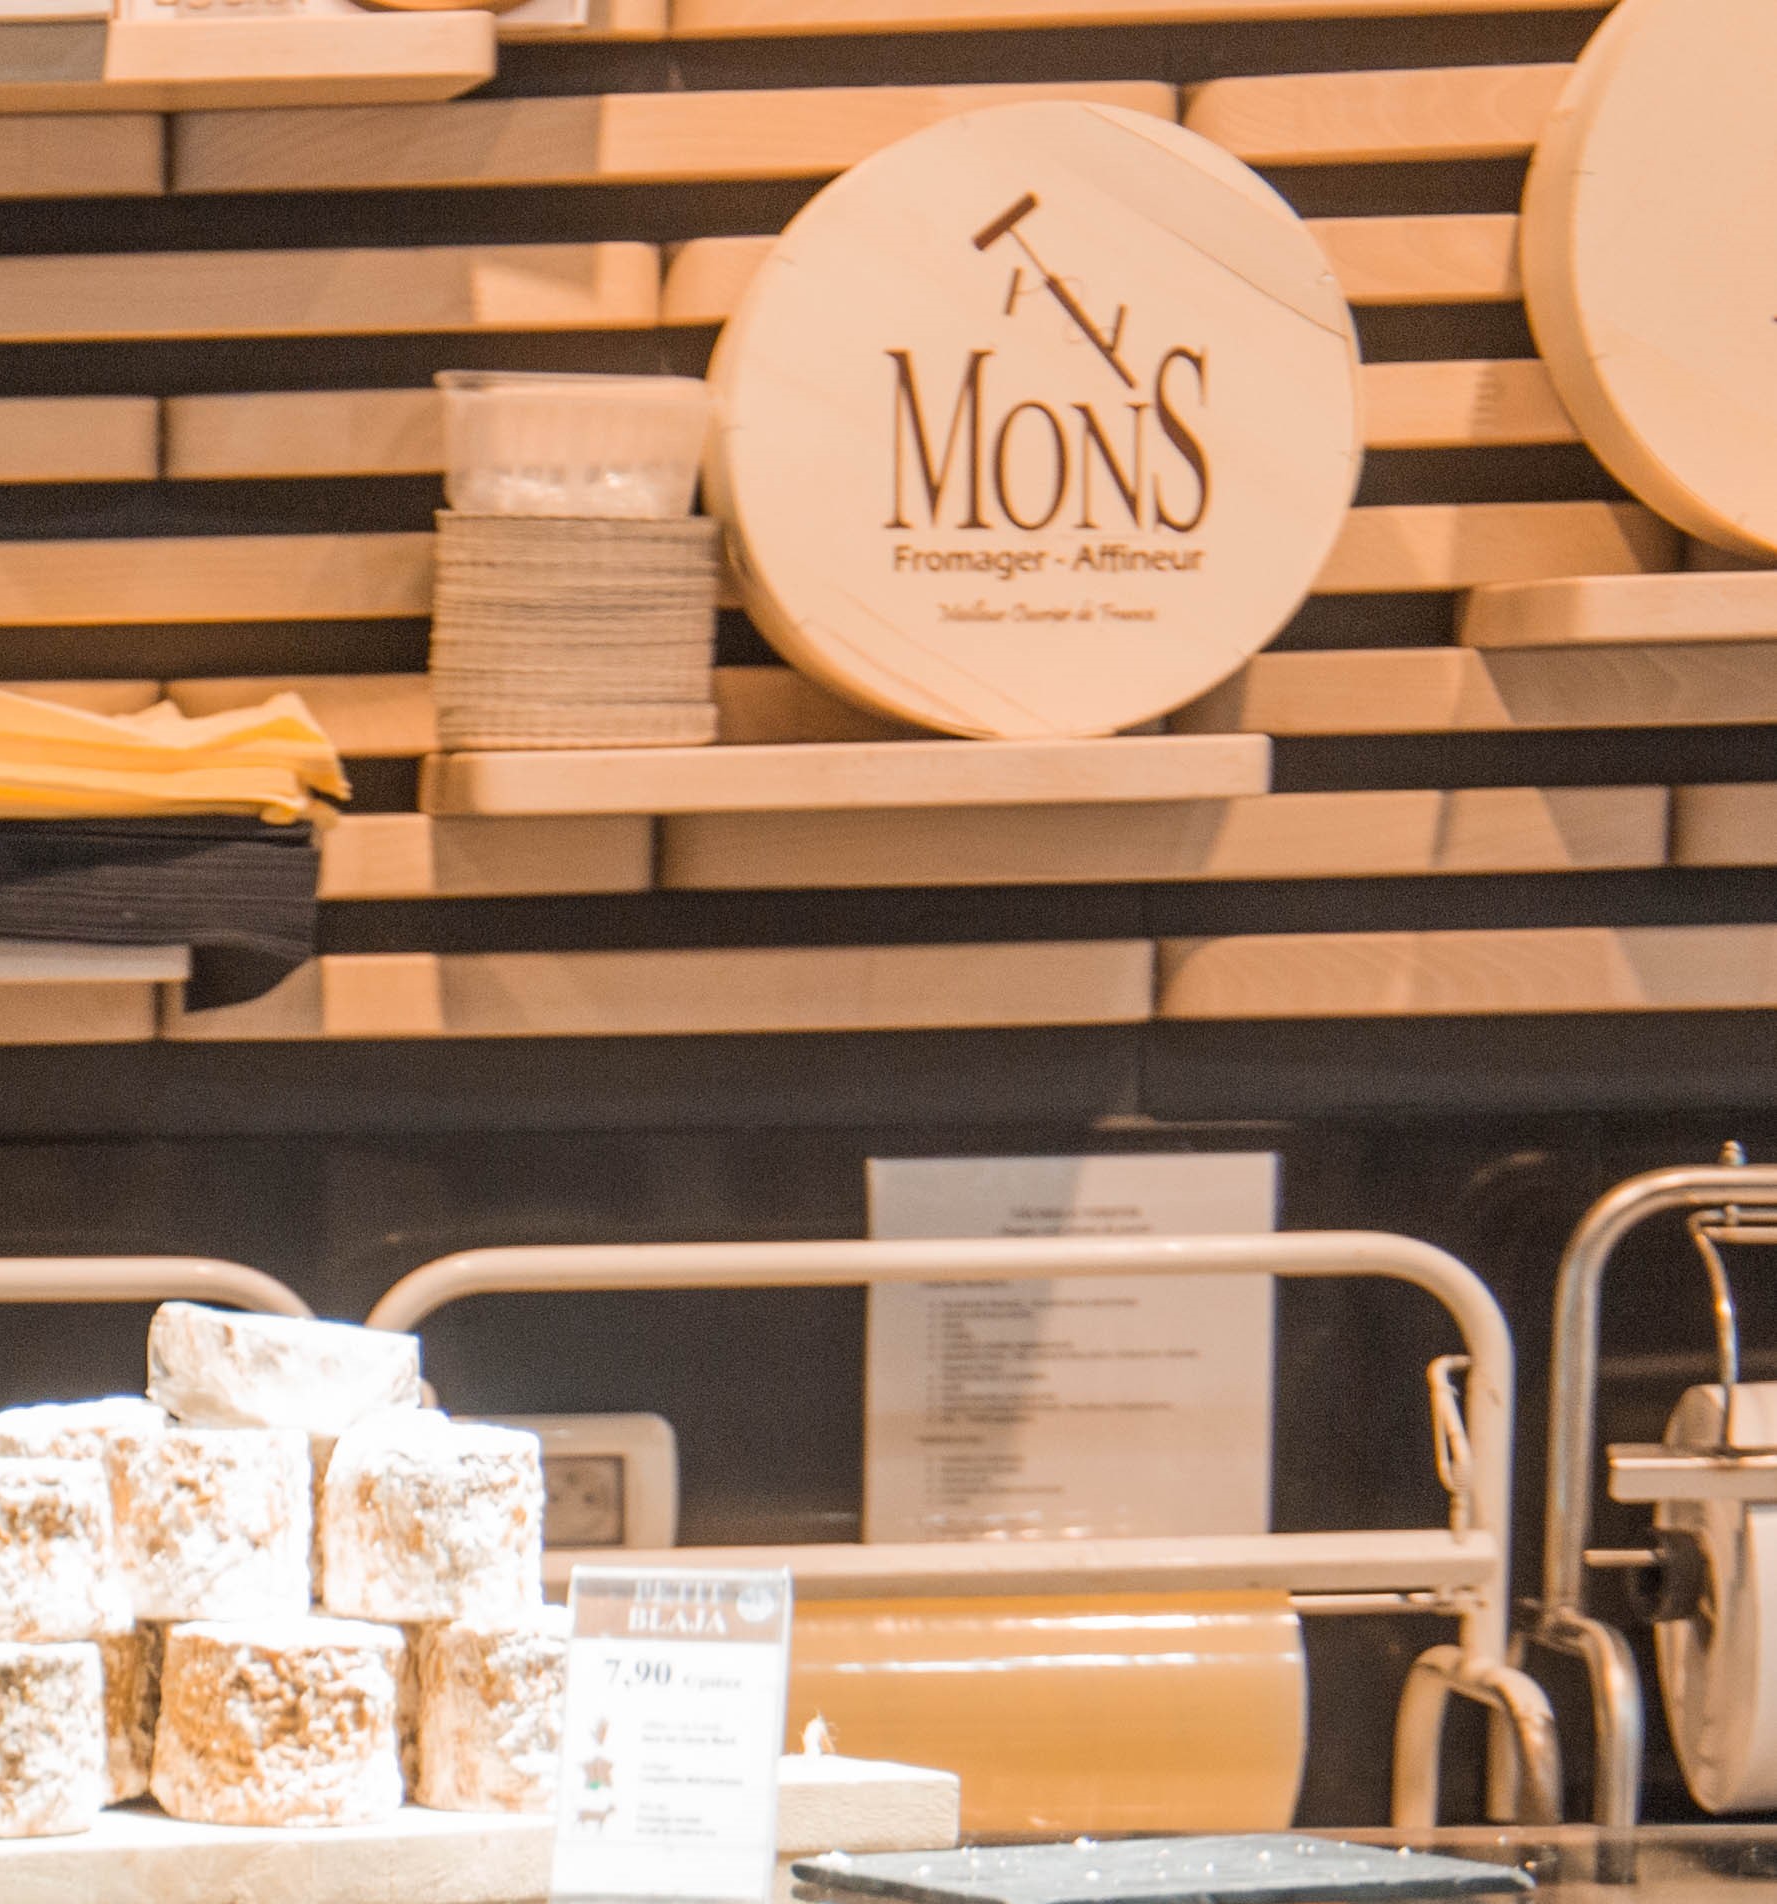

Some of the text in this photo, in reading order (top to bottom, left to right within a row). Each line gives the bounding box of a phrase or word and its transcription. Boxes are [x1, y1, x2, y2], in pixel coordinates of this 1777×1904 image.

[885, 347, 1209, 533] MONS
[893, 545, 1204, 580] Fromager Affineur
[628, 1607, 727, 1634] BLAJA
[604, 1658, 672, 1687] 7,90
